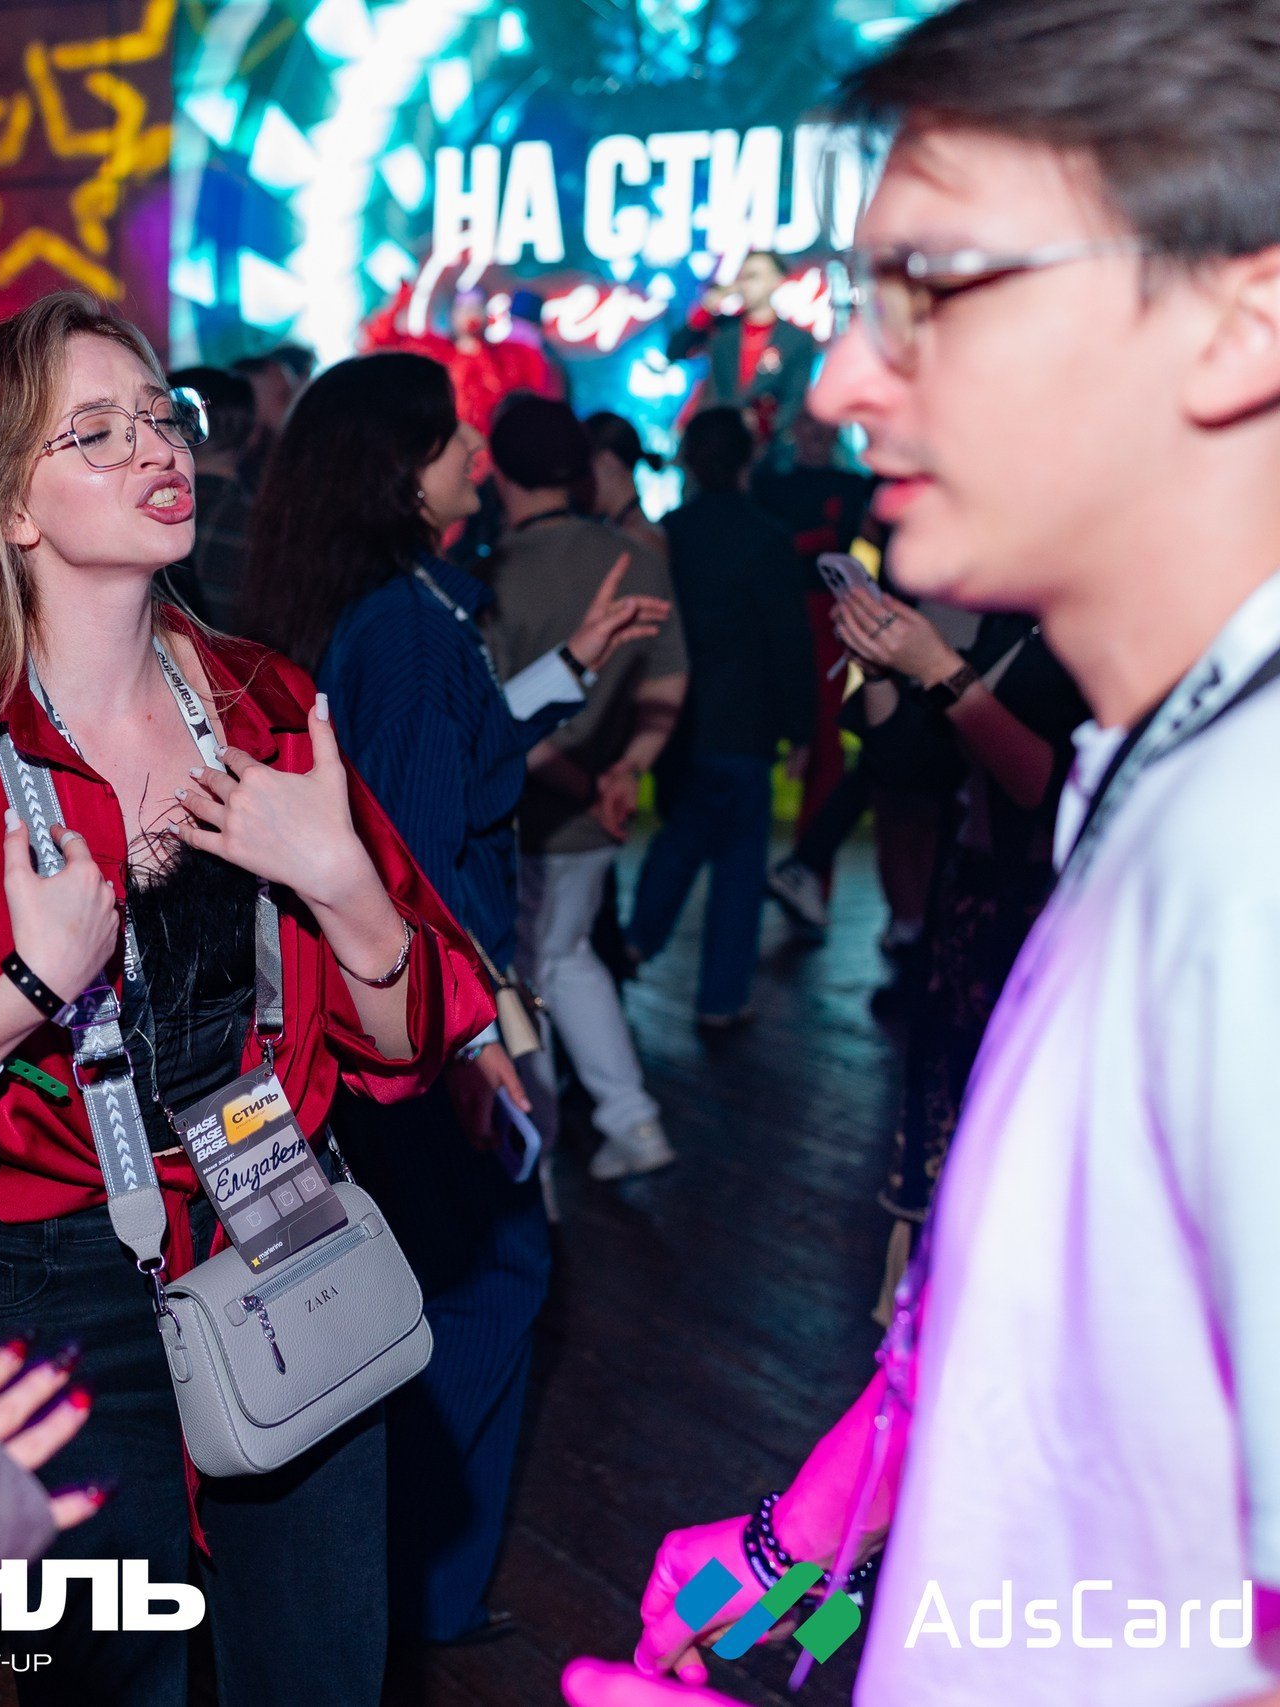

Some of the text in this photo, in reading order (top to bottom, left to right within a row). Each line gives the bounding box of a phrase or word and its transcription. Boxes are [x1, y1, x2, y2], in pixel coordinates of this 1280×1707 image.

[432, 124, 892, 268] НА СТИЛ
[157, 651, 199, 718] marlerino
[232, 1093, 279, 1124] СТИЛЬ
[186, 1114, 217, 1141] BASE
[191, 1125, 223, 1152] BASE
[196, 1135, 228, 1163] BASE
[202, 1161, 218, 1175] Меня
[215, 1138, 308, 1203] Елизавета
[258, 1241, 284, 1260] marlerino
[305, 1285, 339, 1313] ZARA
